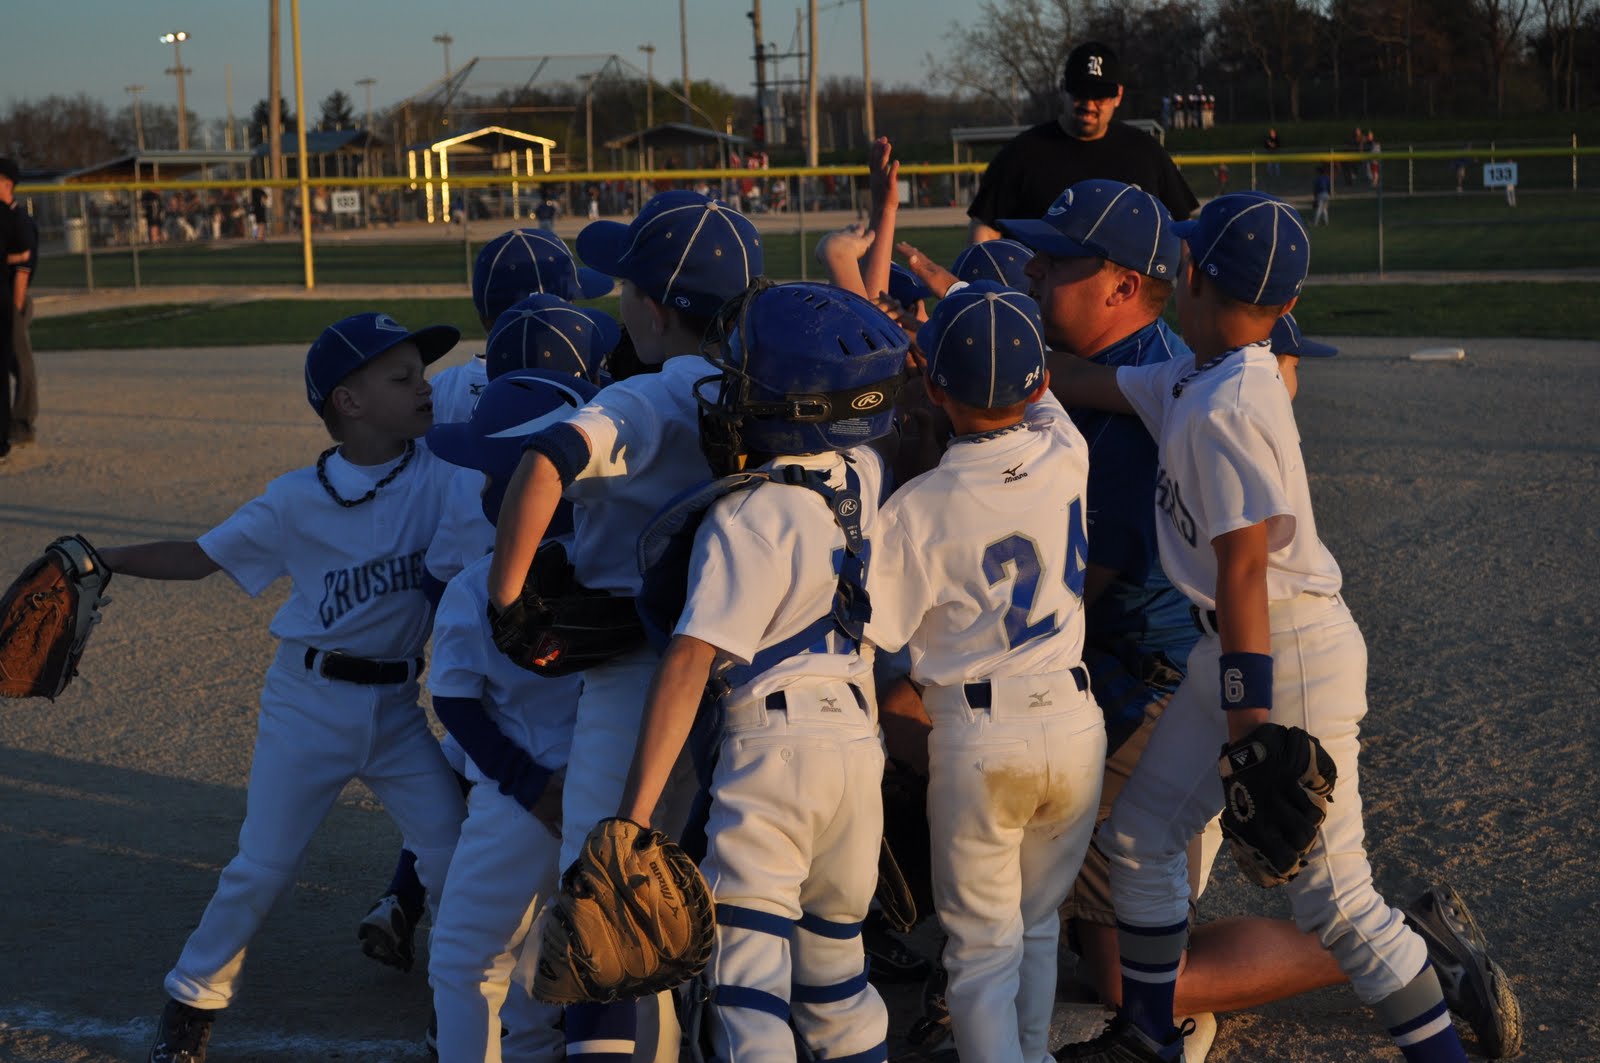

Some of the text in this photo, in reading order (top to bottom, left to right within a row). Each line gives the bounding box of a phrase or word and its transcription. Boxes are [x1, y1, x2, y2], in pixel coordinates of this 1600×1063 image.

[1088, 55, 1103, 77] R
[1490, 167, 1512, 181] 133
[1023, 365, 1040, 389] 24
[1224, 668, 1245, 703] 6
